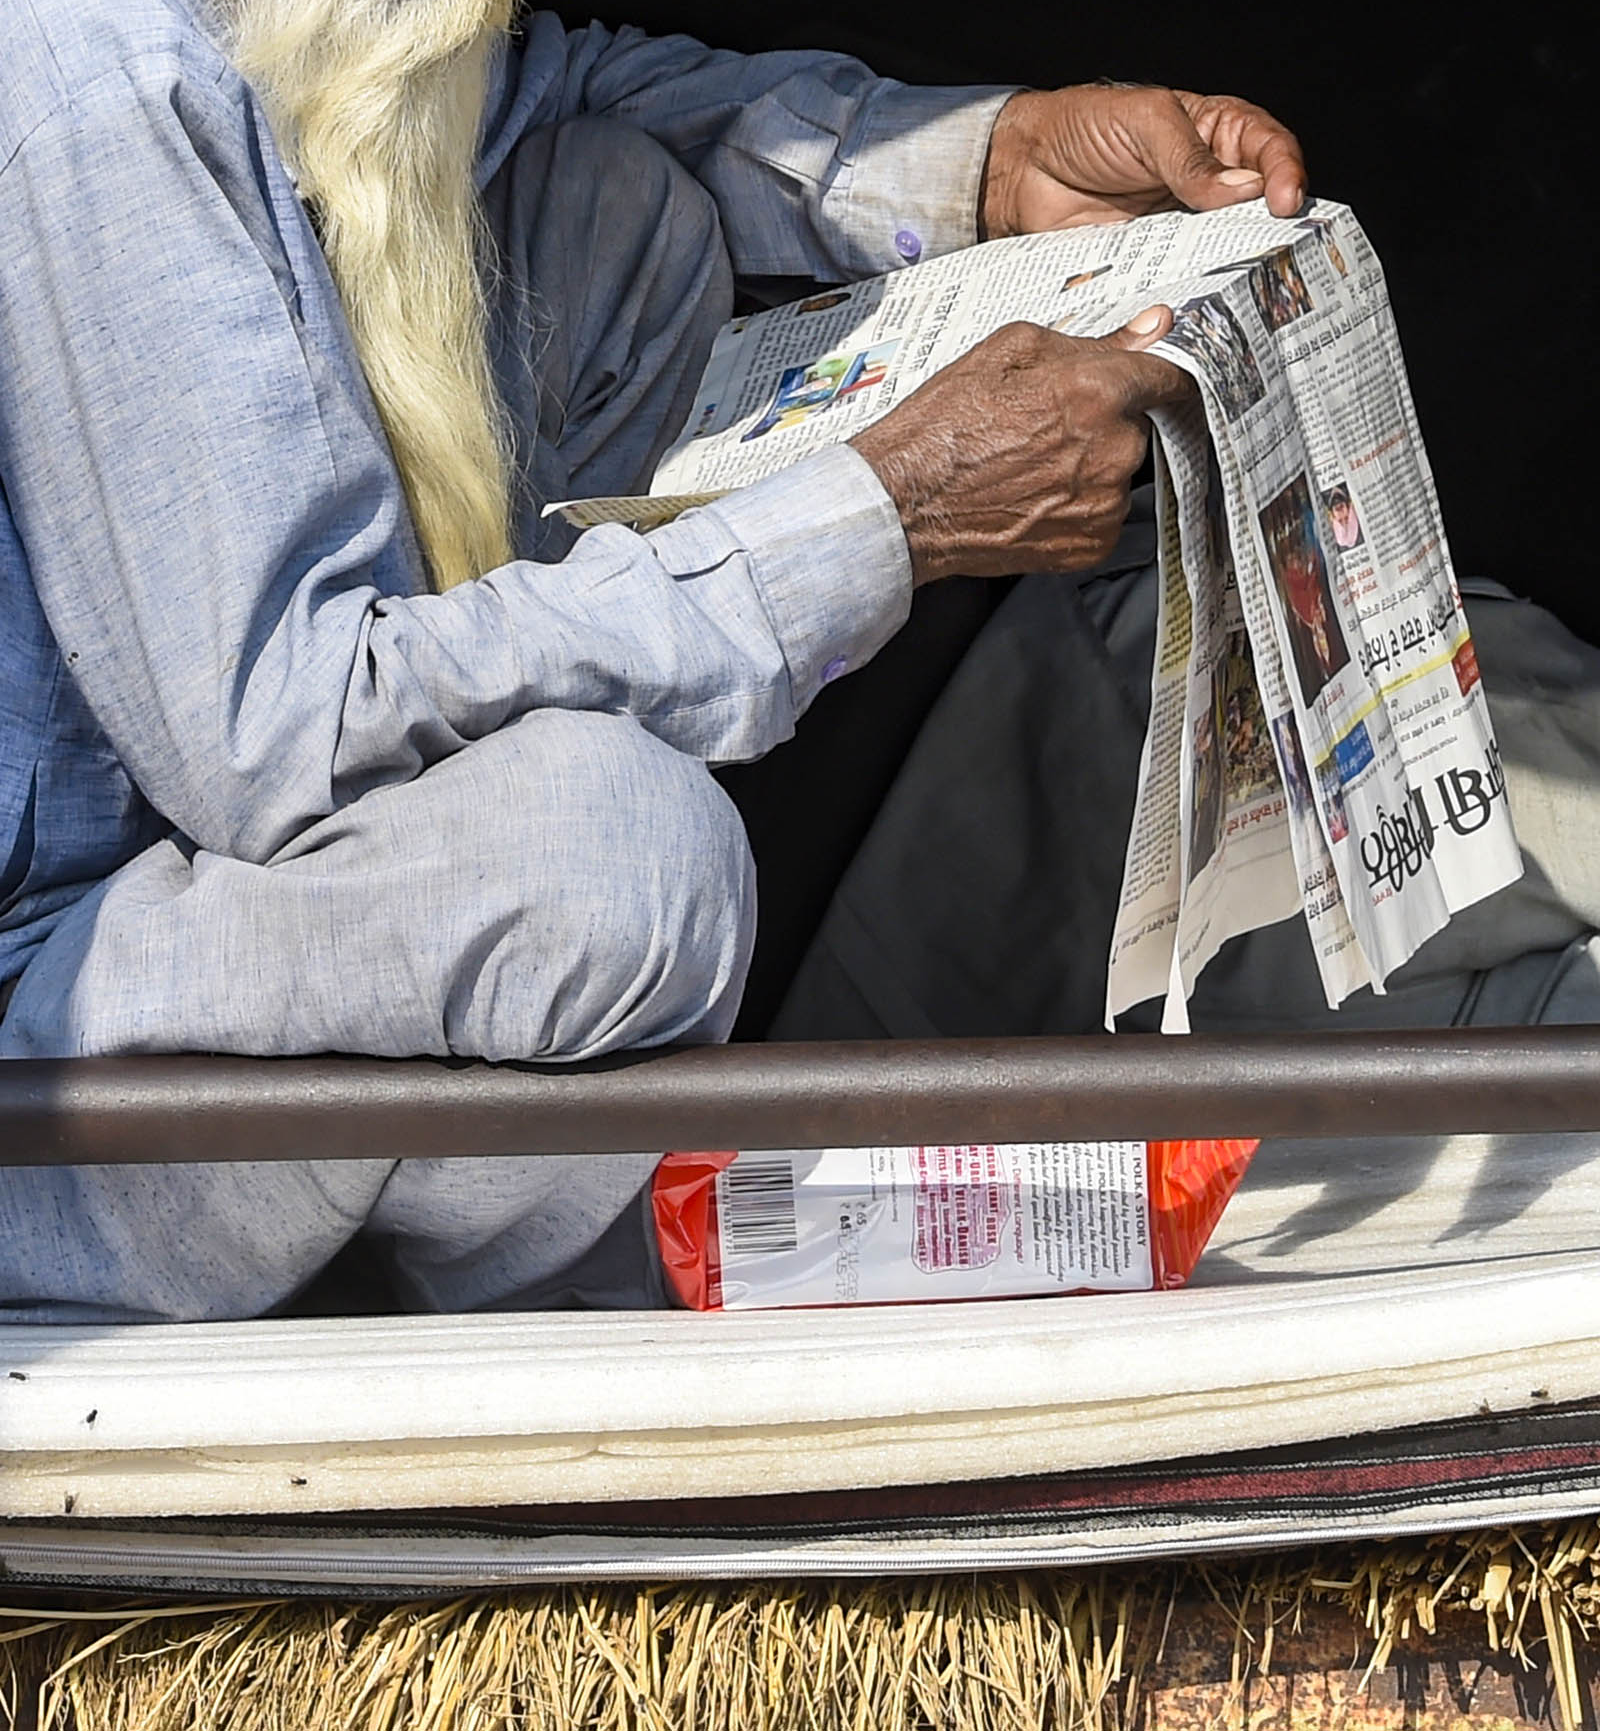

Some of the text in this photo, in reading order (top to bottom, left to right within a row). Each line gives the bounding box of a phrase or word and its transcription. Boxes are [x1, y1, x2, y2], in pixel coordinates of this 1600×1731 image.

[1052, 1146, 1060, 1164] LKA
[1073, 1146, 1081, 1179] fferings
[1013, 1169, 1022, 1208] Different
[1099, 1172, 1107, 1204] POLKA
[1133, 1157, 1143, 1199] POLKA
[1043, 1198, 1051, 1236] mindfully
[1111, 1204, 1120, 1241] unlimited
[1121, 1208, 1129, 1217] by
[1135, 1205, 1146, 1247] STORY
[1013, 1212, 1024, 1263] Languages
[1055, 1228, 1063, 1241] for
[1102, 1248, 1110, 1268] mind
